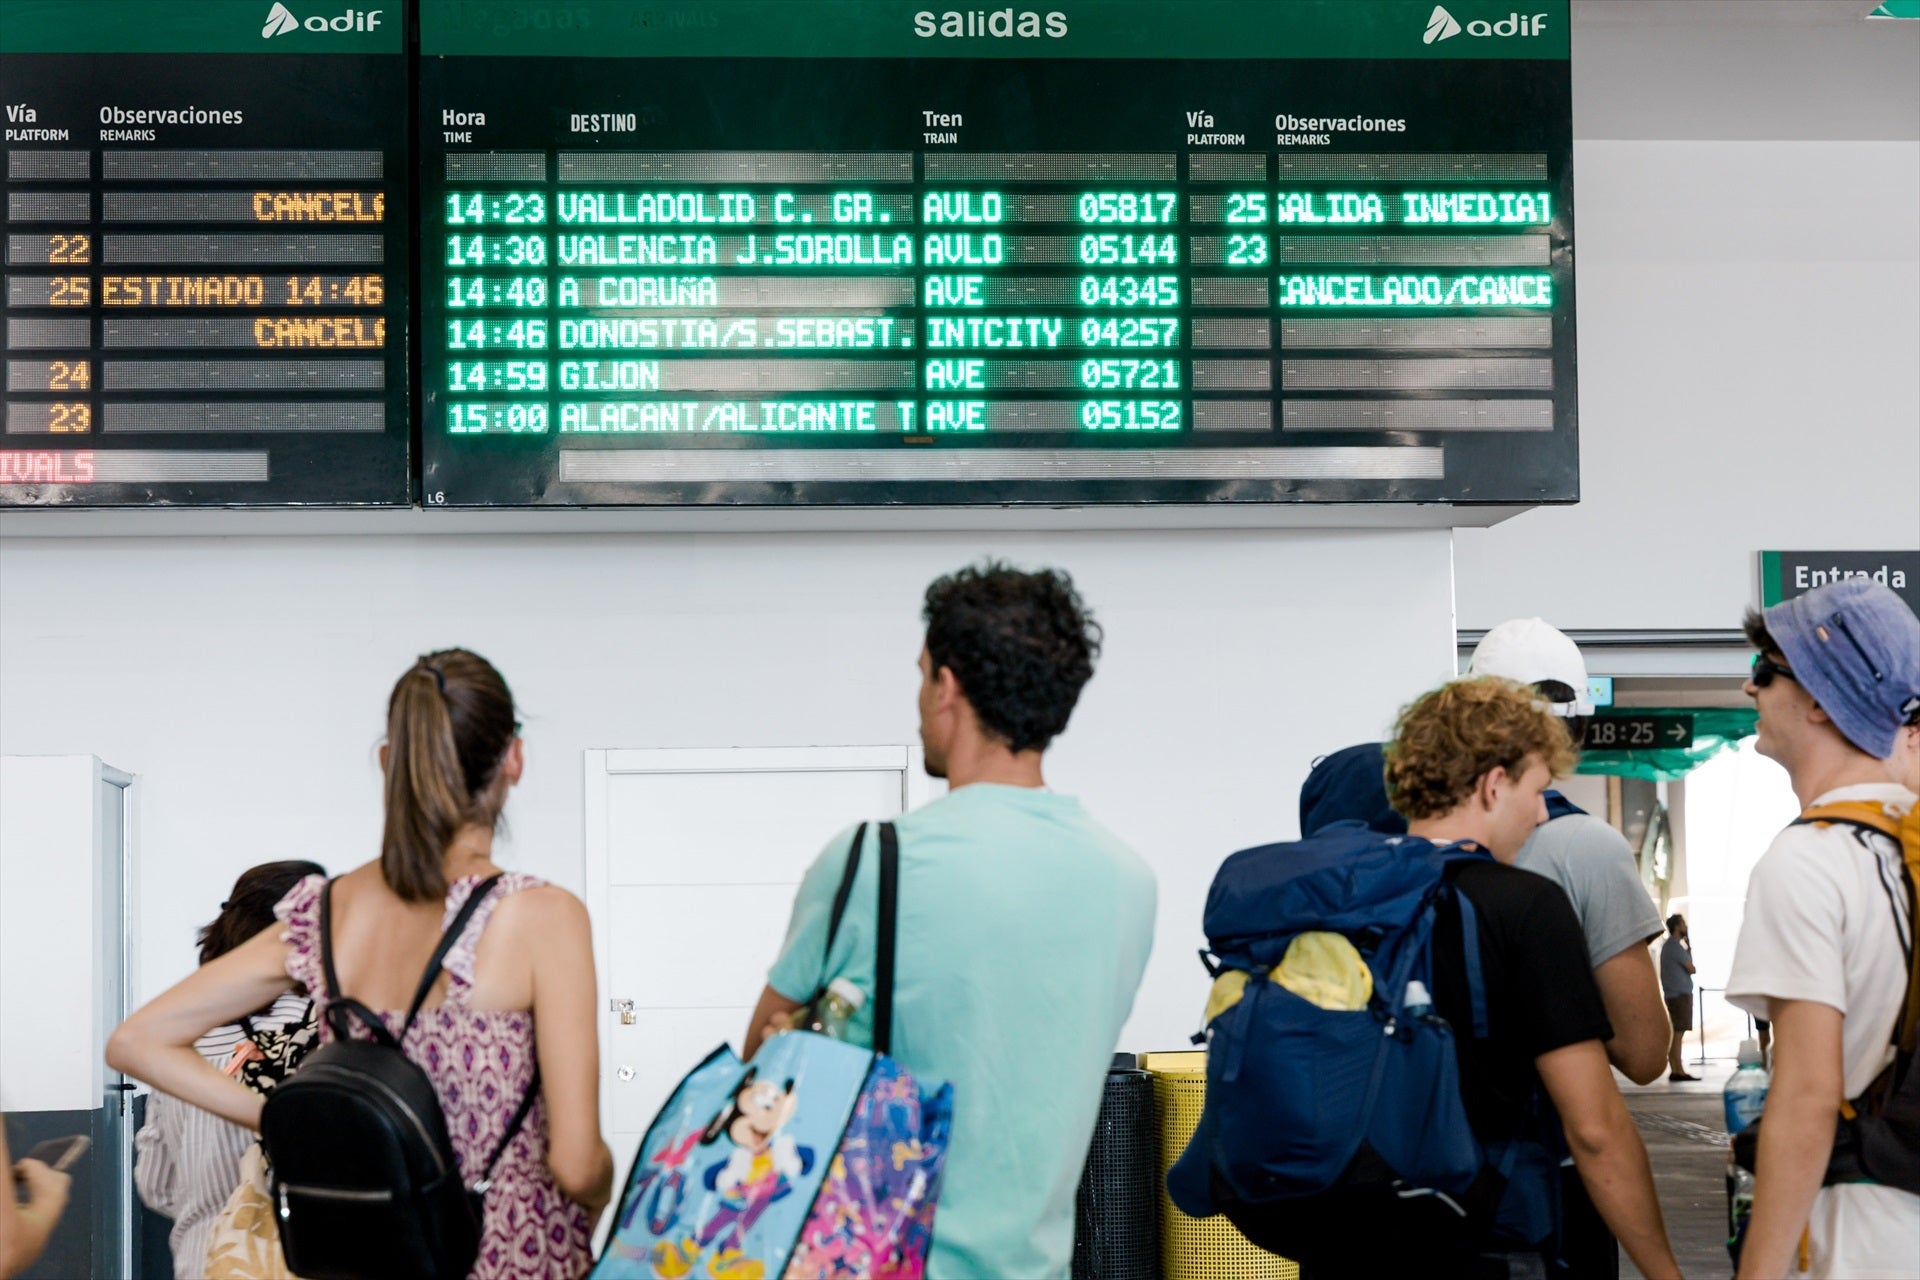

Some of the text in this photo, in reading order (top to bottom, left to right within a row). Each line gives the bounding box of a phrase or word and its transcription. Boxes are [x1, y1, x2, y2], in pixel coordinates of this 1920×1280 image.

[304, 9, 383, 32] adif
[914, 8, 1068, 38] salidas
[1466, 12, 1548, 37] adif
[6, 103, 37, 123] Vía
[99, 105, 243, 125] Observaciones
[442, 109, 486, 126] Hora
[571, 113, 636, 132] DESTINO
[922, 110, 963, 127] Tren
[1186, 110, 1214, 128] Vía
[1275, 114, 1406, 132] Observaciones
[5, 129, 69, 141] PLATFORM
[100, 129, 156, 141] REMARKS
[443, 131, 472, 143] TIME
[923, 132, 958, 144] TRAIN
[1187, 133, 1245, 145] PLATFORM
[1277, 134, 1331, 145] REMARKS
[446, 193, 546, 224] 14:23
[558, 193, 756, 223] VALLADOLID
[775, 193, 812, 223] C.
[833, 193, 890, 223] GR.
[924, 193, 1002, 223] AVLO
[1079, 193, 1176, 223] 05817
[1227, 193, 1267, 223] 25
[49, 235, 89, 263] 22
[447, 235, 1267, 265] 14:30 VALENCIA J.SOROLLA AVLO 05144 23
[50, 276, 383, 305] 25 ESTIMADO 14:46
[447, 277, 546, 307] 14:40
[559, 277, 579, 306] A
[598, 276, 718, 307] CORUÑA
[925, 276, 984, 305] AVE
[1080, 276, 1178, 306] 04345
[448, 318, 1178, 349] 14:46 DONOSTIA/S.SEBAST. INTCITY 04257
[50, 361, 89, 390] 24
[448, 360, 1179, 391] 14:59 GIJON AVE 05721
[50, 403, 90, 432] 23
[449, 401, 1179, 433] 15:00 ALACANT/ALICANTE T AVE 05152
[427, 491, 445, 504] L6
[1591, 722, 1654, 744] 18:25
